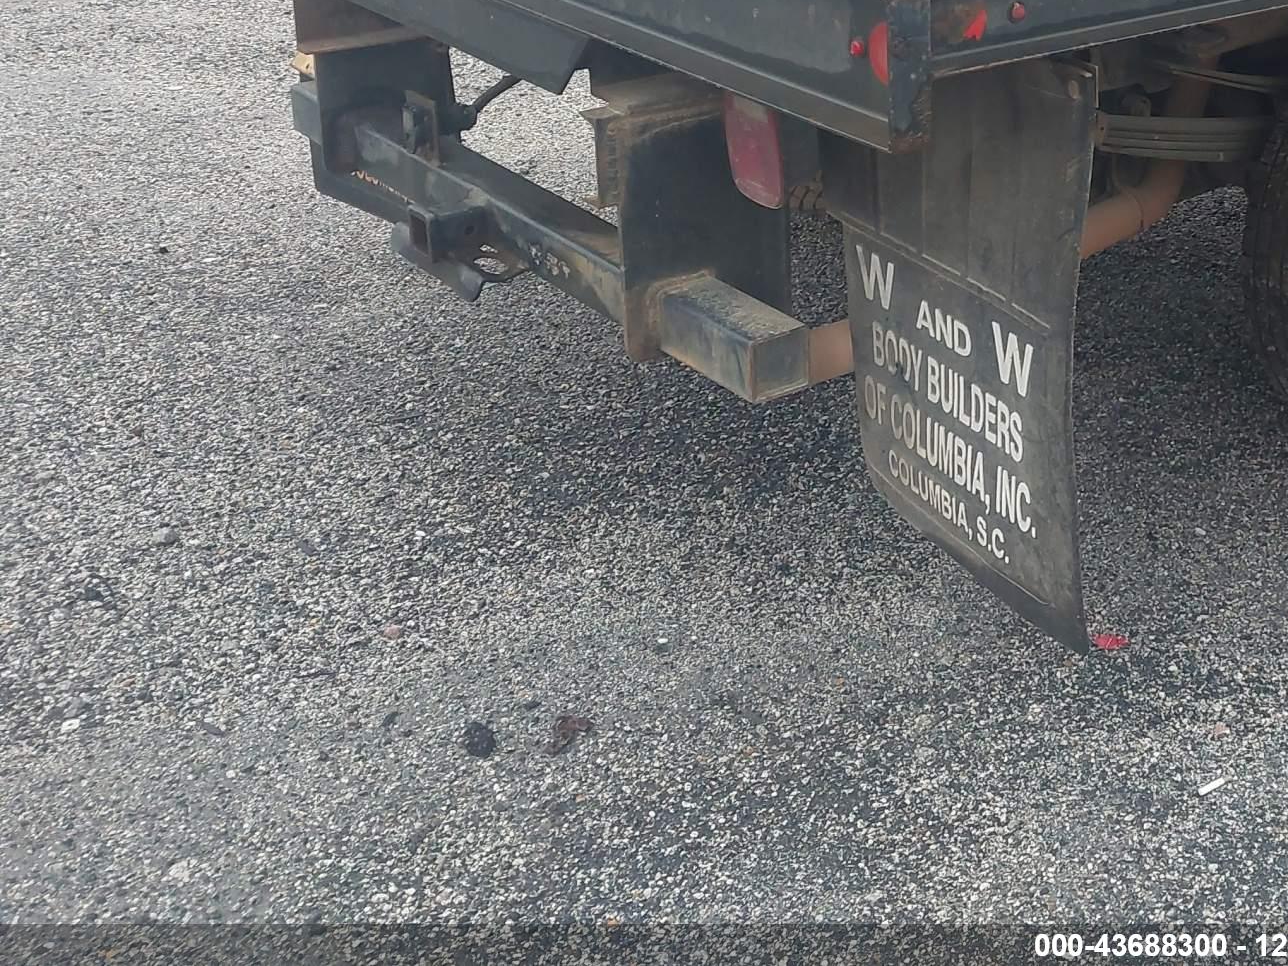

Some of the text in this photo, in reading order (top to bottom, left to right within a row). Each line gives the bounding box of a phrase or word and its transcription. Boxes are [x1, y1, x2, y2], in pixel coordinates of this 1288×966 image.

[856, 244, 1034, 398] W AND W
[872, 321, 1024, 464] BODY BUILDERS
[864, 374, 1037, 539] OF COLUMBIA, INC.
[888, 449, 1011, 564] COLUMBIA, S.C.
